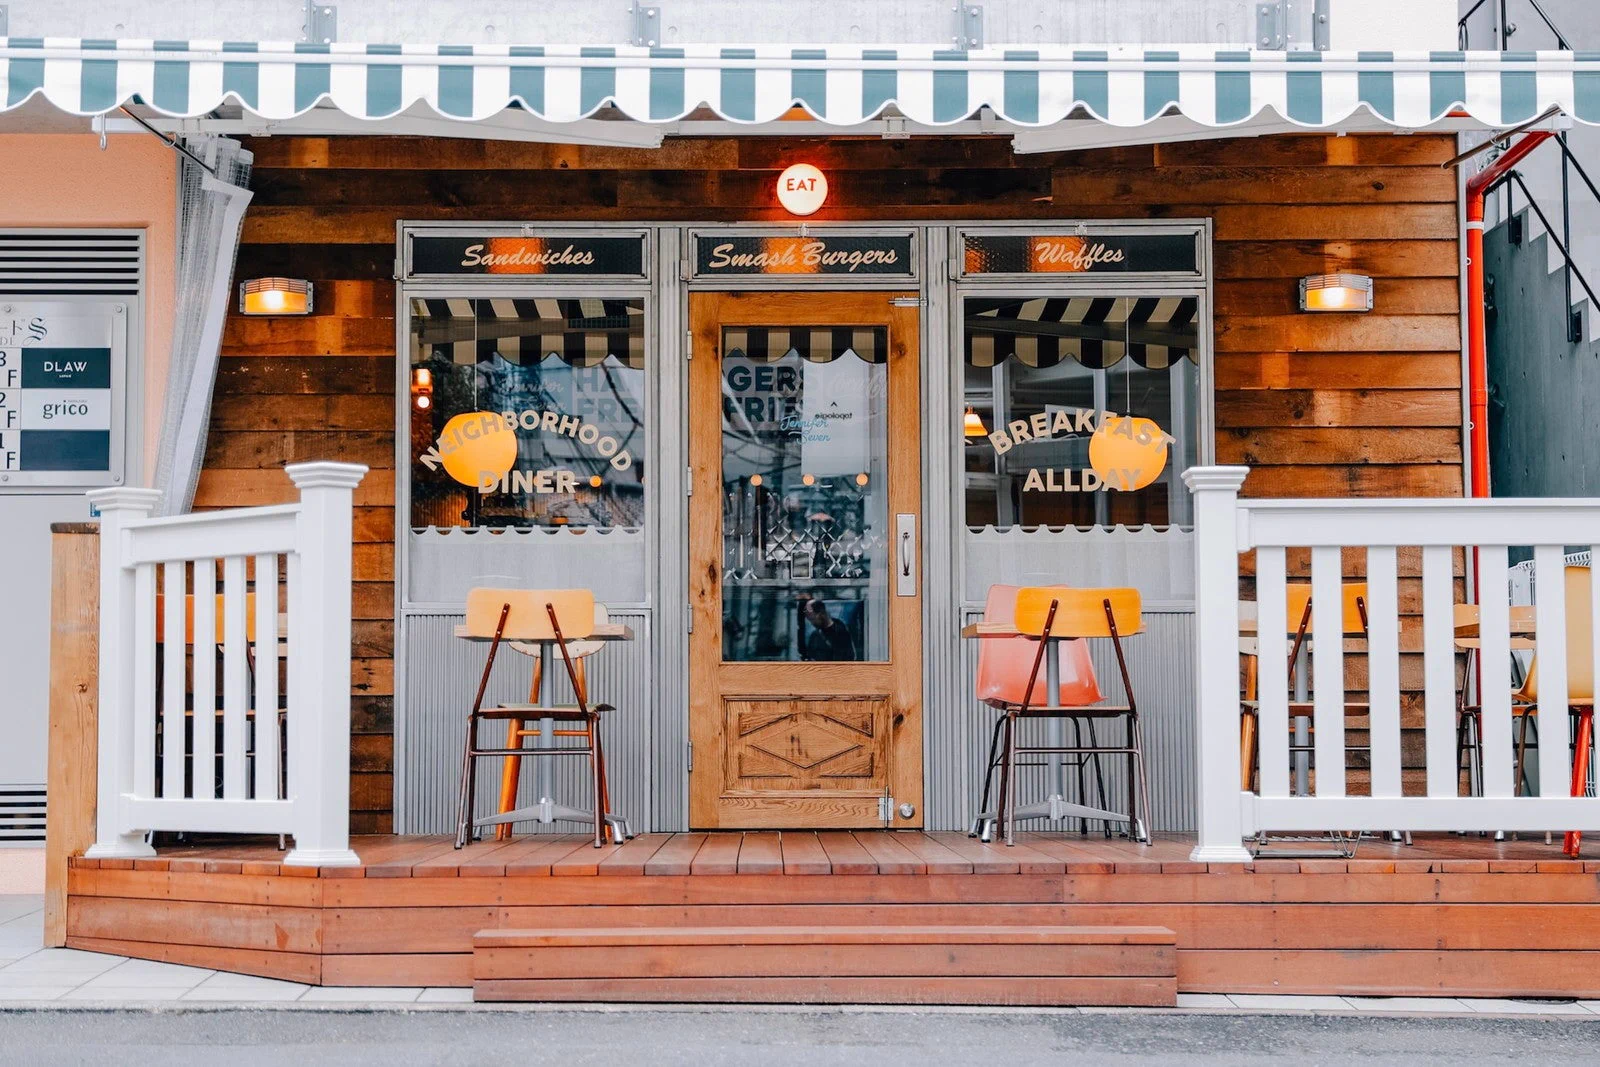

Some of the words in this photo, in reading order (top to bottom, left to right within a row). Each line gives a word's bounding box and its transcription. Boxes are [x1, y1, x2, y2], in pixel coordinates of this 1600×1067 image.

[786, 178, 817, 192] EAT
[461, 244, 595, 267] Sandwiches
[709, 243, 797, 268] Smash
[801, 242, 899, 272] Burgers
[1035, 242, 1125, 270] Waffles
[43, 361, 88, 373] DLAW
[43, 400, 88, 419] grico
[419, 409, 632, 472] NEIGHBORHOOD
[988, 409, 1177, 456] BREAKFAST
[478, 469, 576, 494] DINER
